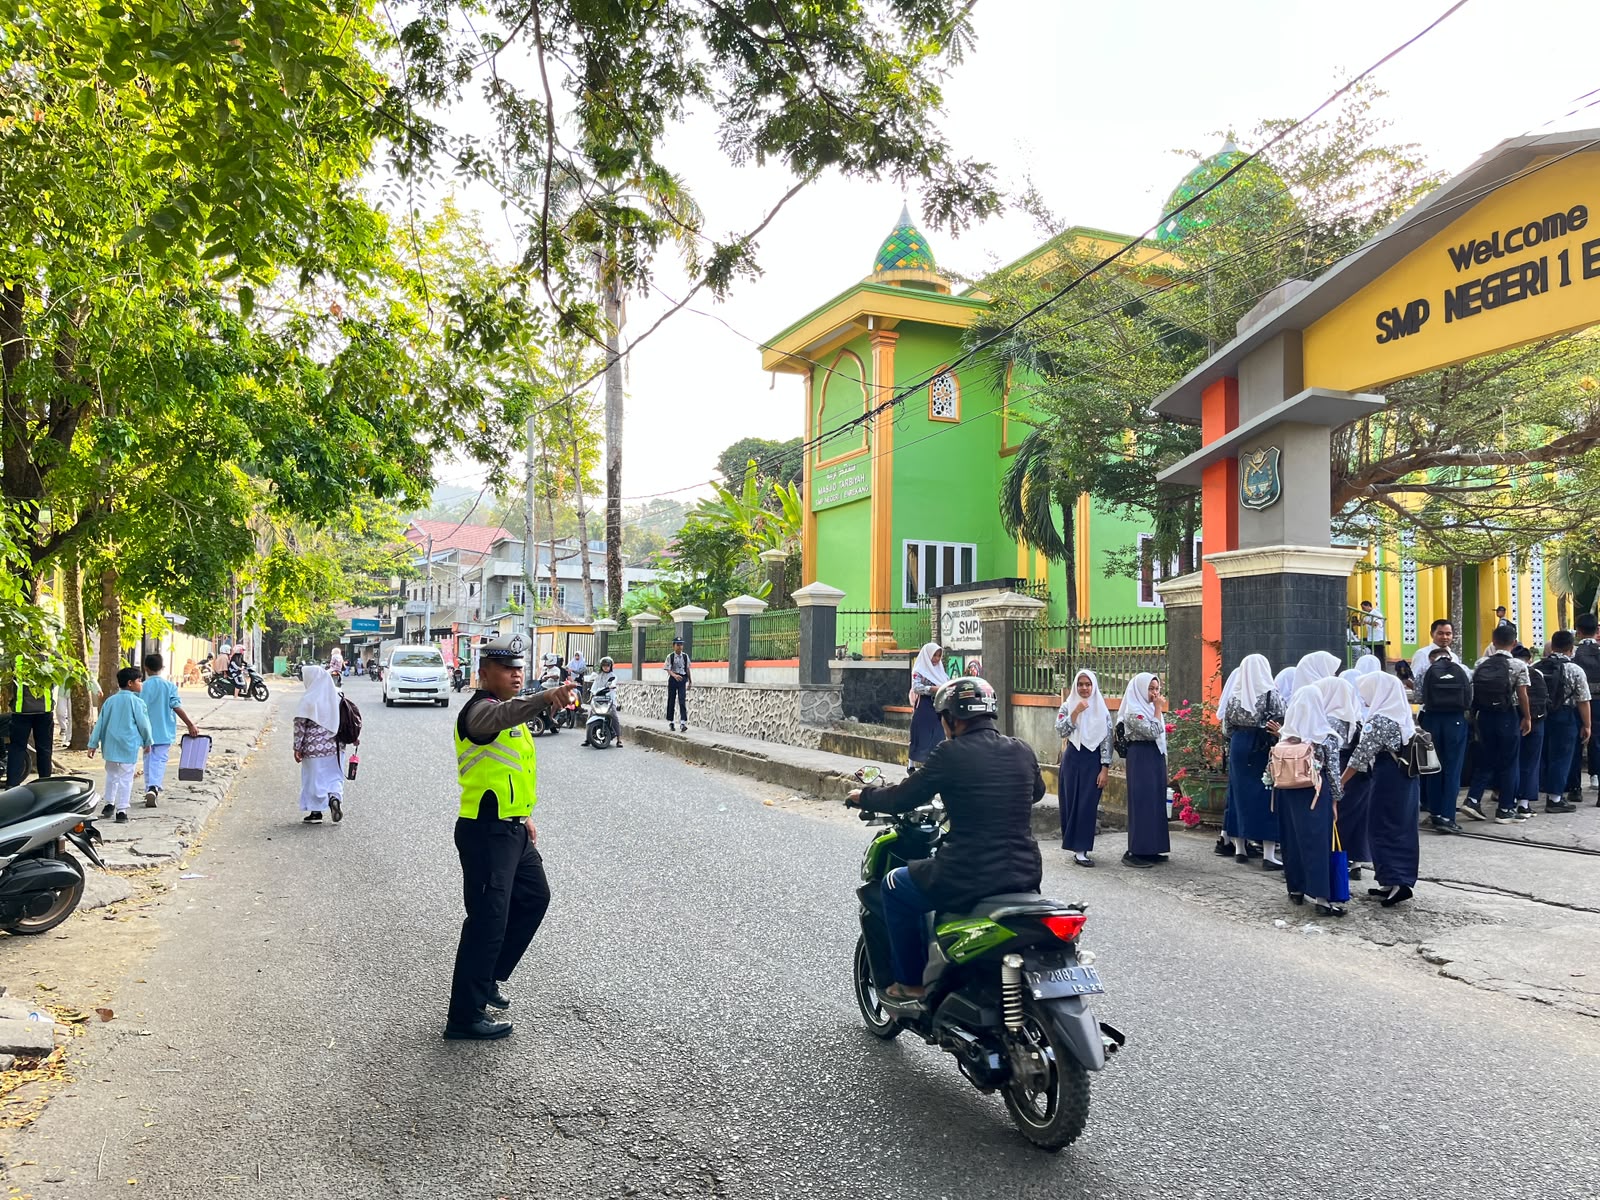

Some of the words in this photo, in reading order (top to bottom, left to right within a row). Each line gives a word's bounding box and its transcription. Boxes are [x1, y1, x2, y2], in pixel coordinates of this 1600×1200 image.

[1448, 205, 1588, 272] Welcome
[1375, 298, 1430, 344] SMP
[1445, 256, 1549, 323] NEGERI
[1557, 248, 1571, 287] 1
[839, 474, 866, 487] TARBIYAH
